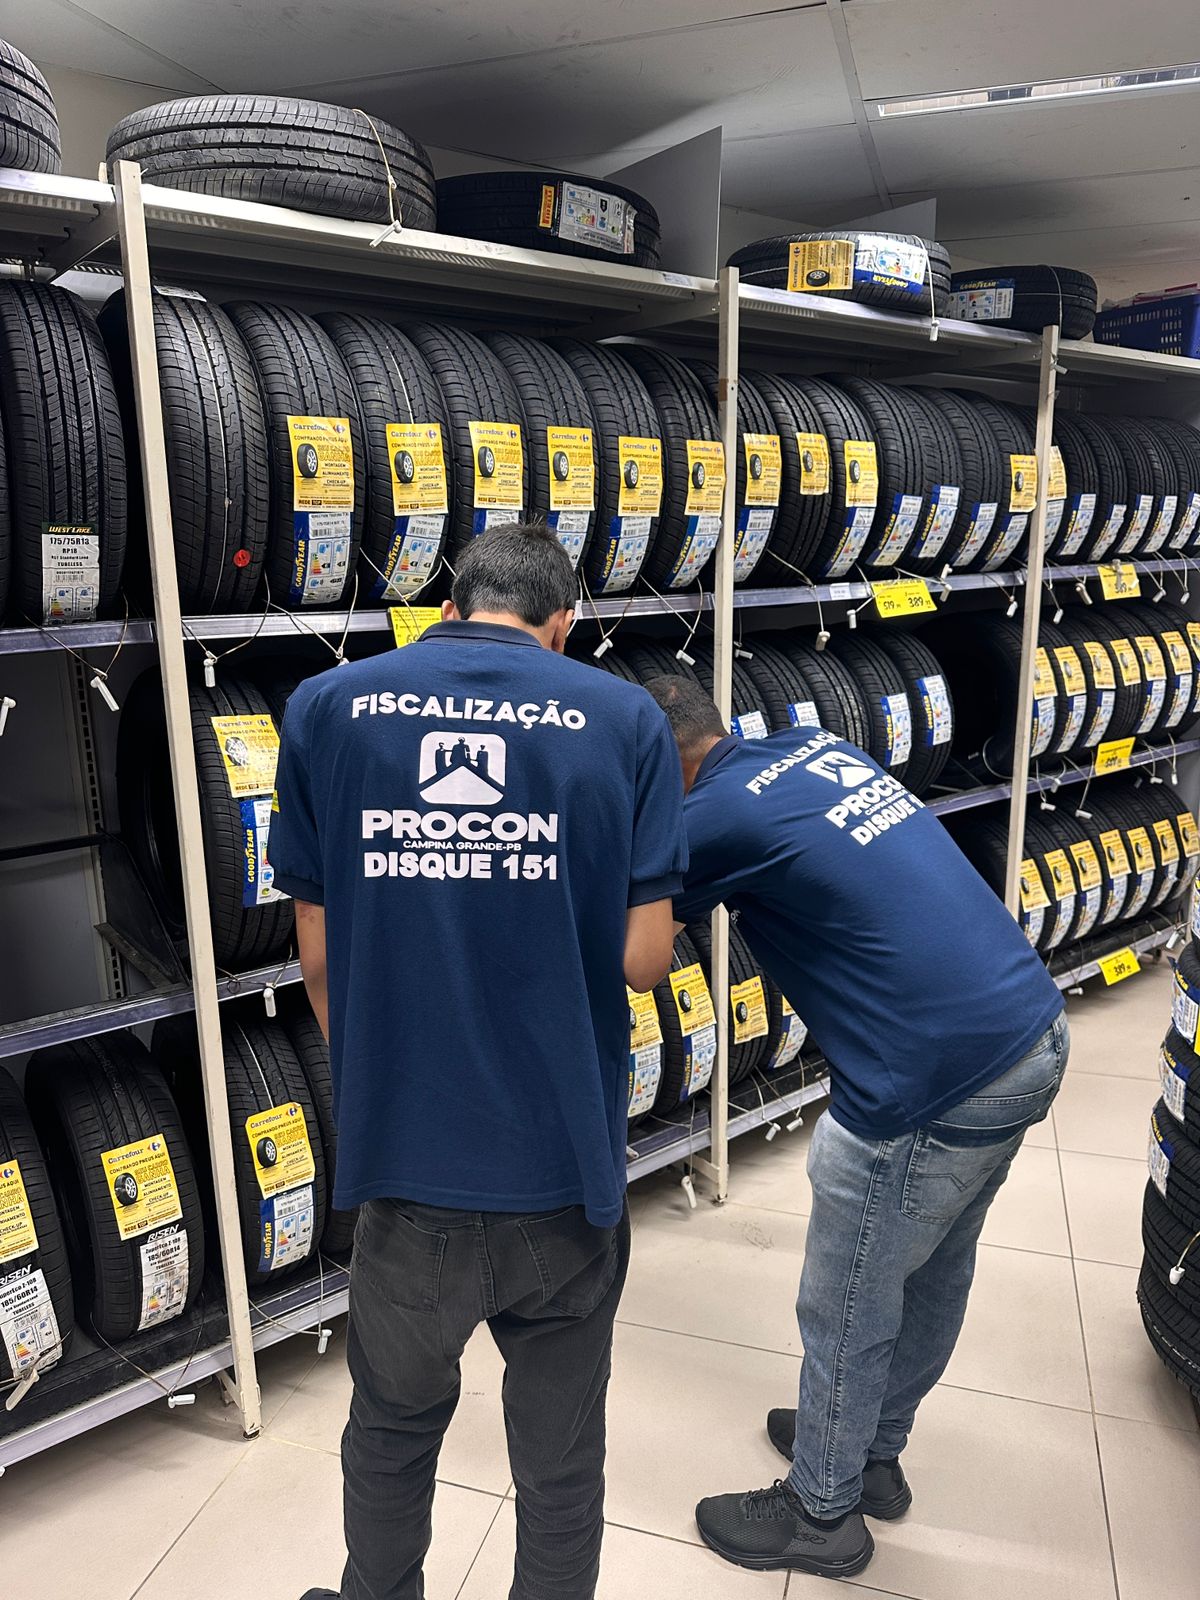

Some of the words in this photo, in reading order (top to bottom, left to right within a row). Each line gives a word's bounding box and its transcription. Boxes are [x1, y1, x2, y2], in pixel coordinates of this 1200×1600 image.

[50, 537, 90, 545] 175/75R13
[295, 540, 305, 588] GOODYEAR
[352, 692, 586, 730] FISCALIZAÇÃO
[824, 774, 906, 829] PROCO
[362, 809, 558, 842] PROCON
[850, 798, 917, 846] DISQUE
[403, 840, 454, 850] CAMPINA
[456, 841, 522, 851] GRANDE-PB
[246, 829, 255, 883] GOODYEAR
[364, 852, 492, 880] DISQUE
[502, 854, 557, 880] 151
[250, 1114, 283, 1128] Carrefour
[108, 1148, 144, 1164] Carrefour
[6, 1179, 19, 1187] AQUI
[0, 1206, 20, 1216] ONTAGEM
[0, 1212, 25, 1223] NHAMENTO
[0, 1286, 21, 1299] uperEco
[1, 1286, 38, 1308] 185/60R14
